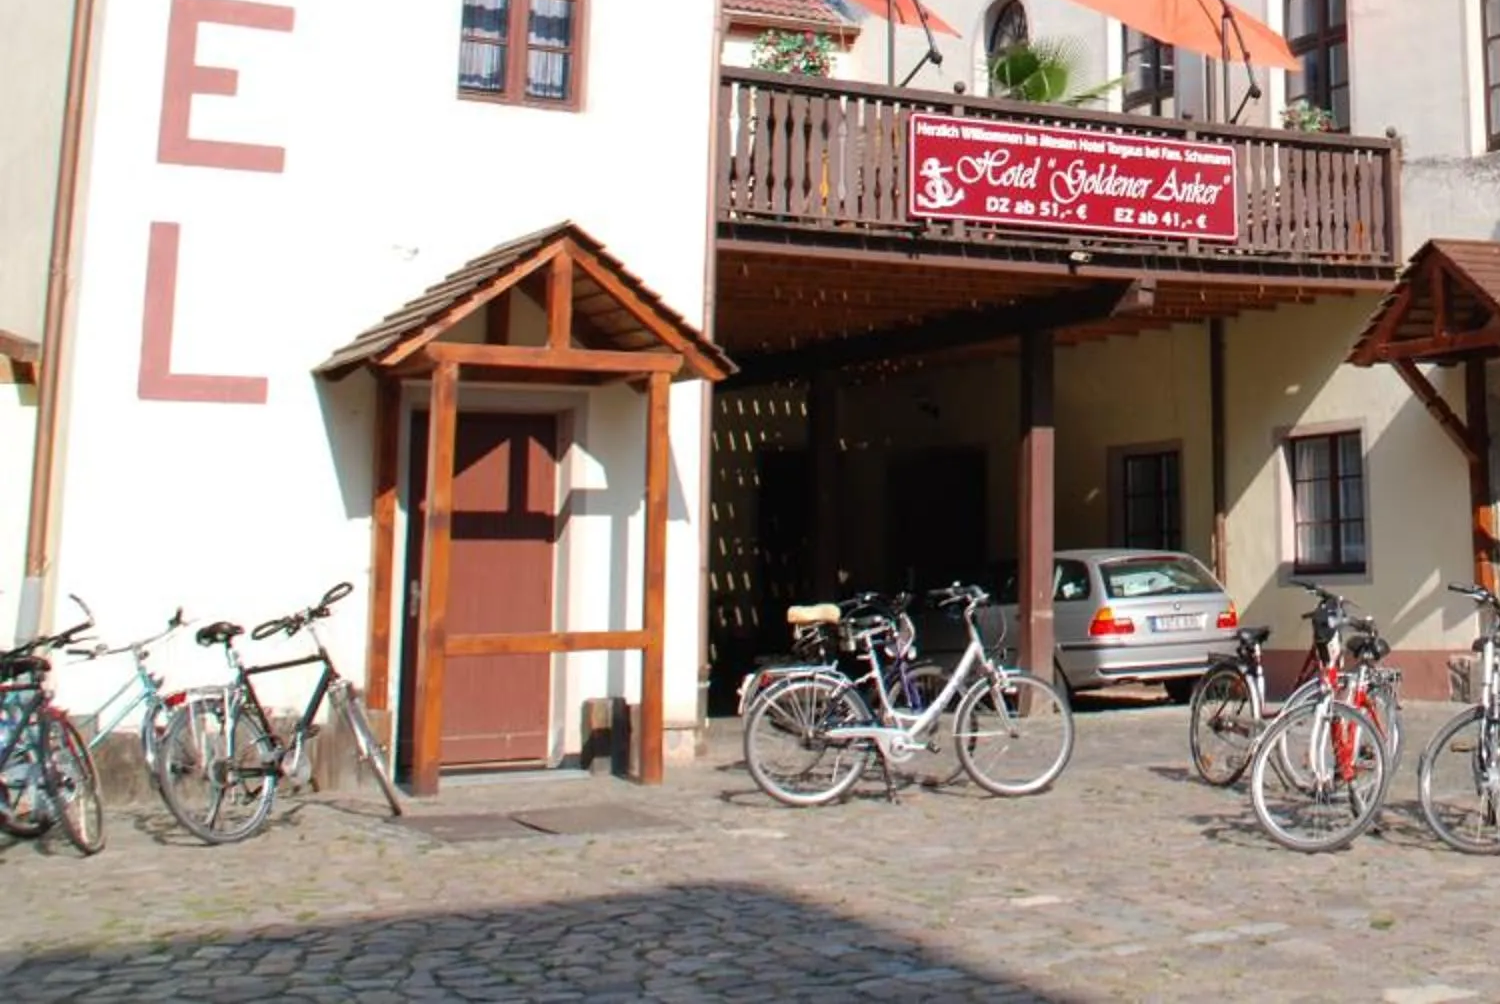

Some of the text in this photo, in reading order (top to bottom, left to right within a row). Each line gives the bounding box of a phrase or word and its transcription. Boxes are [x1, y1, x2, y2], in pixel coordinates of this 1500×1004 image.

[916, 122, 959, 138] Herzlich
[1079, 138, 1105, 153] Hotel
[957, 149, 1041, 189] Hotel
[986, 196, 1011, 212] DZ
[1014, 199, 1035, 215] ab
[1076, 204, 1088, 220] €
[1114, 207, 1135, 223] EZ
[1138, 209, 1159, 225] ab
[1196, 214, 1208, 229] €
